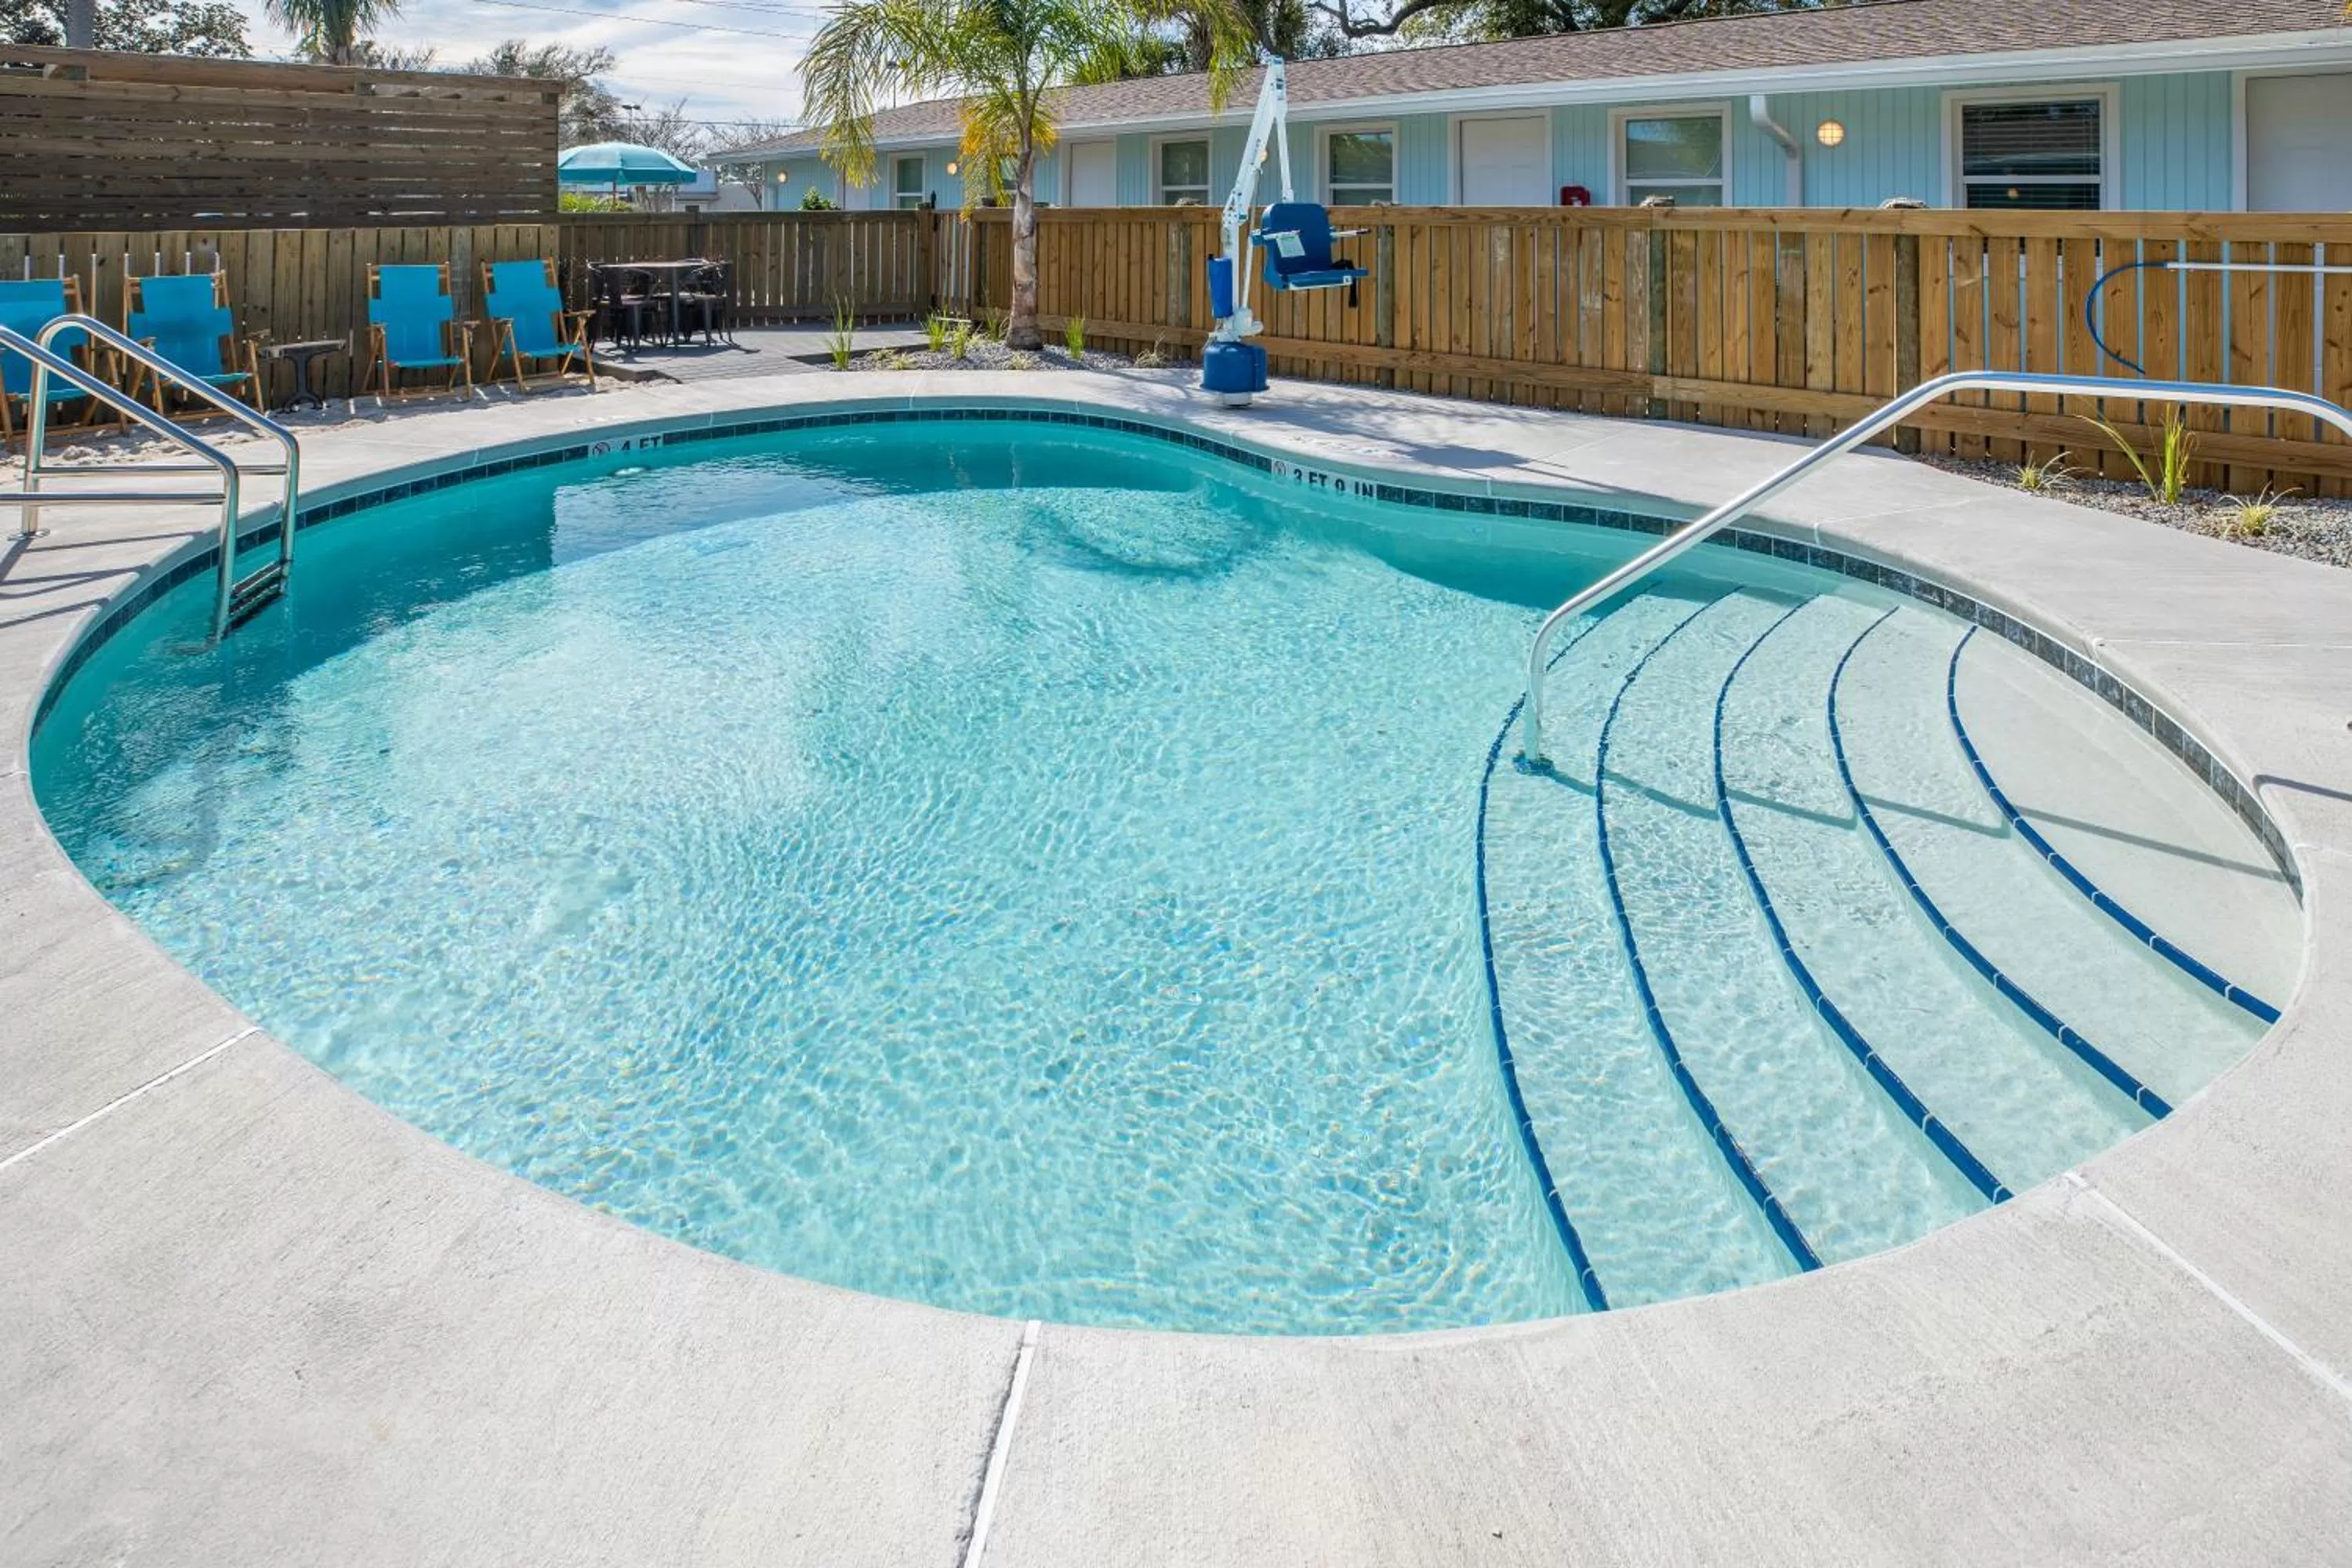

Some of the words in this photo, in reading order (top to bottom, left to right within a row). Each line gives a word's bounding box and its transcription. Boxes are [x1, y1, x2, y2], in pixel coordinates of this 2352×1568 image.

[639, 435, 661, 449] FT
[1308, 471, 1327, 487] FT
[1354, 481, 1374, 498] IN
